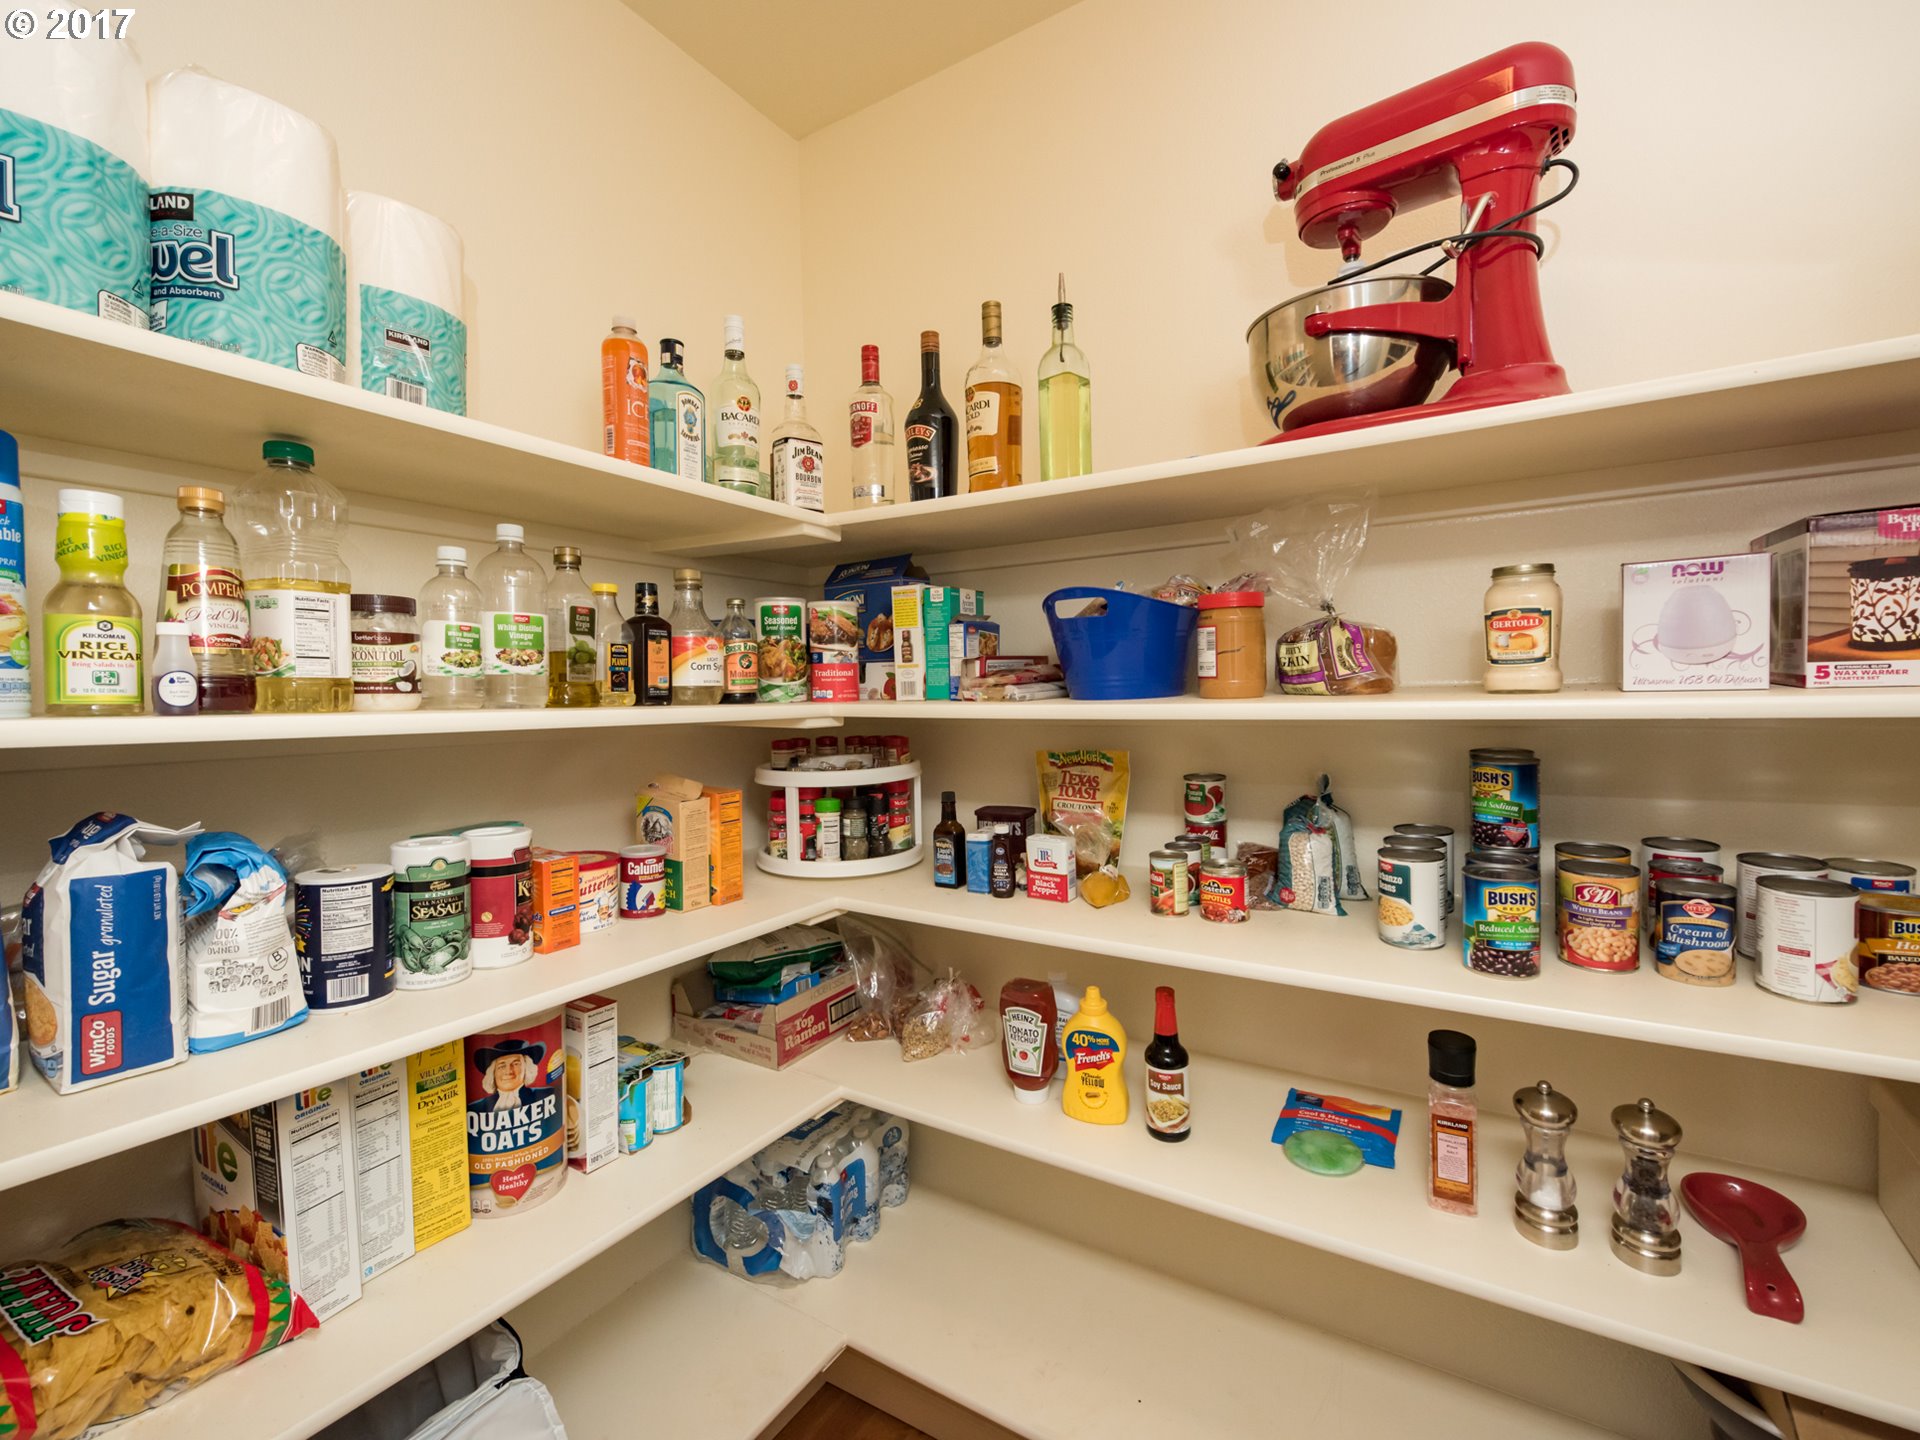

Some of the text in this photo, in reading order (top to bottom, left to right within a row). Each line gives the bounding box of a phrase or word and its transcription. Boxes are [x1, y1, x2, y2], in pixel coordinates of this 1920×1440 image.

[150, 195, 190, 210] LAND
[151, 224, 202, 238] e-a-Size
[150, 229, 240, 290] wel
[153, 287, 221, 299] and Absorbent
[388, 331, 428, 346] KIRKAND
[852, 401, 876, 412] RNOFF
[966, 400, 990, 415] CARDI
[721, 412, 760, 426] BACARD
[905, 426, 932, 438] AILEYS
[795, 472, 822, 484] BOURBON
[1887, 513, 1920, 525] Bette
[57, 537, 74, 549] ICE
[57, 543, 91, 560] NEGAR
[96, 548, 127, 562] VINEGA
[0, 557, 17, 566] PRAY
[185, 606, 222, 623] Red
[764, 616, 798, 625] Seasoned
[209, 622, 240, 630] VINEGAR
[497, 623, 516, 632] White
[1493, 618, 1540, 629] BERTOLLI
[509, 632, 535, 641] Vinegar
[80, 641, 129, 651] RICE
[58, 650, 142, 661] VINEGAR
[352, 650, 388, 661] OCONUT
[690, 662, 712, 671] Corn
[815, 669, 854, 677] Traditional
[1814, 665, 1831, 680] 5
[729, 670, 758, 679] Molass
[1061, 770, 1100, 788] TEXAS
[1472, 770, 1510, 786] BUSH'S
[1058, 784, 1100, 800] TOAST
[1056, 801, 1097, 811] CROUTONS
[1488, 801, 1519, 812] Sodium
[1035, 879, 1057, 888] Black
[1380, 872, 1403, 885] banzo
[1033, 885, 1060, 895] Pepper
[1487, 891, 1536, 906] BUSH'S
[99, 884, 123, 946] granulated
[1571, 903, 1623, 916] WHITE BEANS
[215, 928, 238, 940] 00%
[1479, 923, 1539, 934] Reduced Sodiu
[1669, 923, 1729, 940] Cream of
[1894, 921, 1920, 934] BUS
[1665, 931, 1730, 948] Mushroom
[207, 945, 240, 955] OWNED
[88, 951, 122, 1006] Sugar
[794, 1014, 815, 1032] Top
[1011, 1012, 1035, 1024] HEINZ
[784, 1020, 826, 1051] Ramen
[1008, 1023, 1040, 1038] TOMATO
[90, 1020, 106, 1068] WinCo
[106, 1027, 116, 1056] FOODS
[1010, 1031, 1039, 1045] KETCHUP
[1072, 1032, 1096, 1047] 40%
[1075, 1050, 1111, 1065] French's
[419, 1062, 453, 1079] VILLAGE
[359, 1070, 391, 1086] ORIGINAL
[1080, 1075, 1105, 1088] YELLOW
[1150, 1079, 1182, 1091] Soy Sauce
[355, 1080, 398, 1099] Nutrition Facts
[417, 1089, 459, 1110] Dry Milk
[294, 1101, 331, 1120] ORIGINAL
[467, 1094, 557, 1137] QUAKER
[290, 1111, 338, 1135] Nutrition Facts
[1437, 1119, 1469, 1130] KIRKLAND
[481, 1120, 542, 1152] OATS
[474, 1146, 549, 1170] OLD FASHIONED
[502, 1171, 525, 1183] Heart
[498, 1178, 529, 1191] Healthy
[119, 1260, 155, 1278] Bag
[88, 1266, 143, 1292] Fiesta
